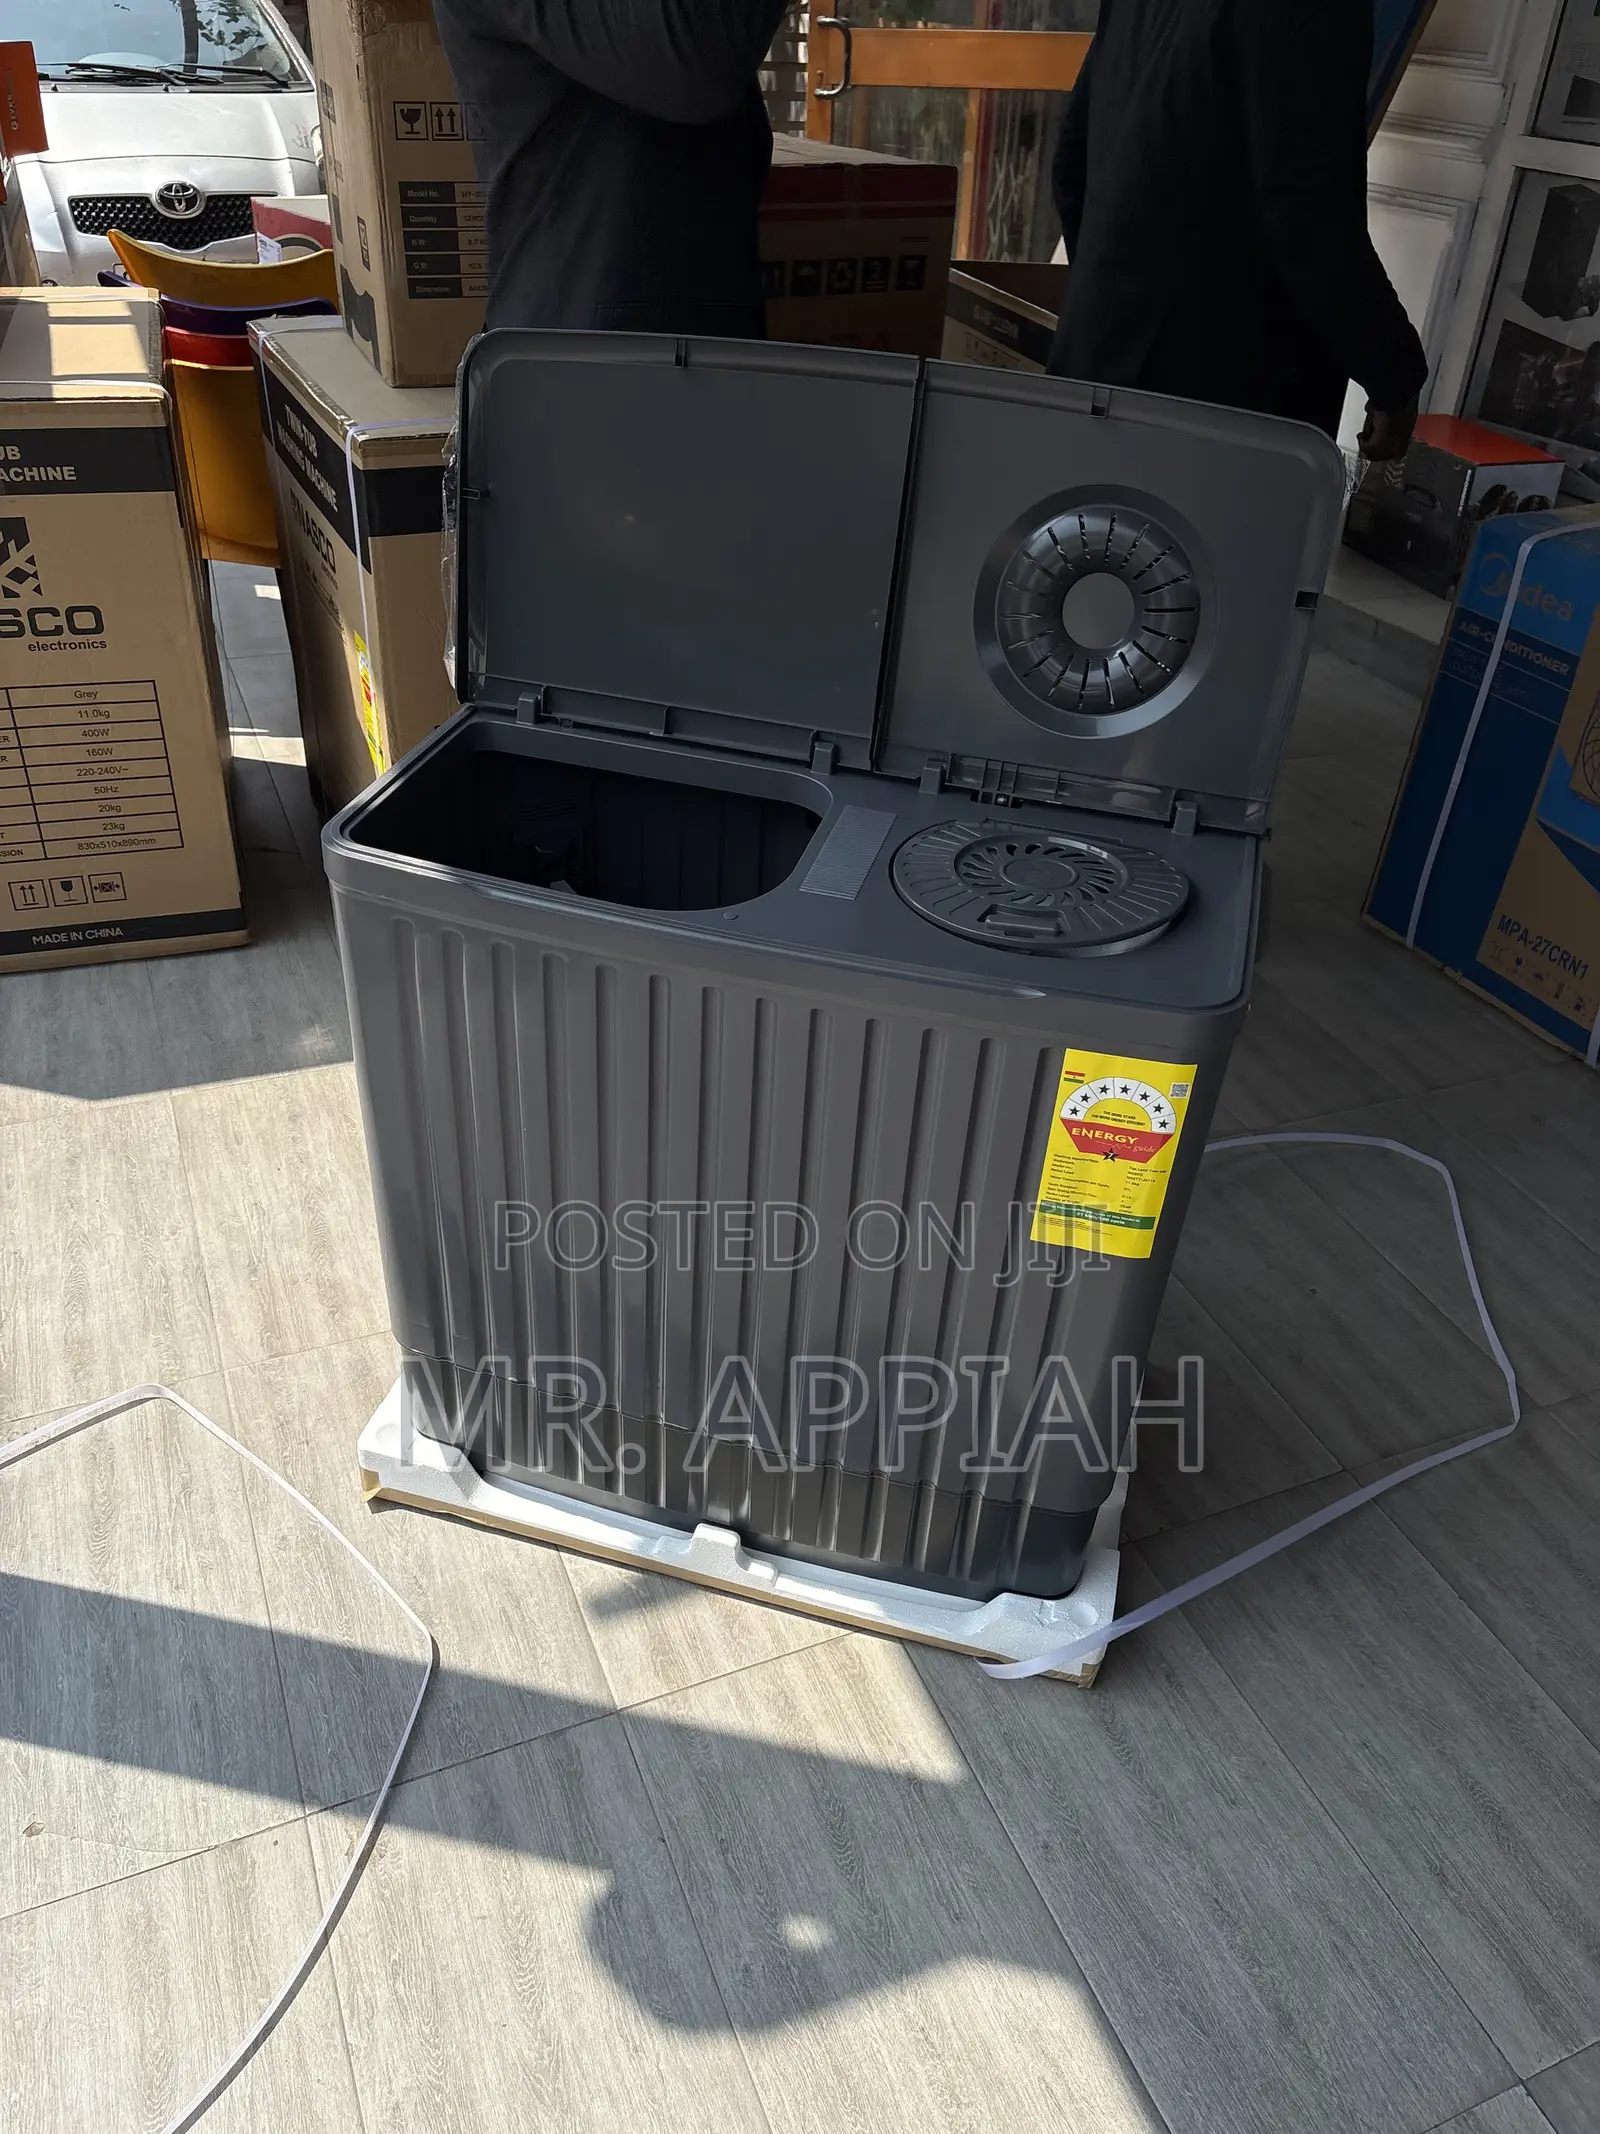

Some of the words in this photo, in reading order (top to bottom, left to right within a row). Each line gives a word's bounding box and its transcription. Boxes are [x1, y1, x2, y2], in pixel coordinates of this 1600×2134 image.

[27, 639, 107, 652] electronics
[1458, 621, 1570, 676] AIR-CNDITIONER
[74, 689, 98, 700] Grey
[78, 709, 111, 720] 11.0kg
[81, 728, 110, 738] 400W
[86, 747, 114, 757] 160W
[94, 785, 119, 794] 50Hz
[98, 804, 122, 814] 20kg
[102, 822, 126, 832] 23kg
[32, 933, 68, 945] MADE
[70, 931, 83, 941] IN
[86, 927, 124, 940] CHINA
[1071, 1127, 1139, 1144] ENERGY
[1132, 1145, 1156, 1153] guide
